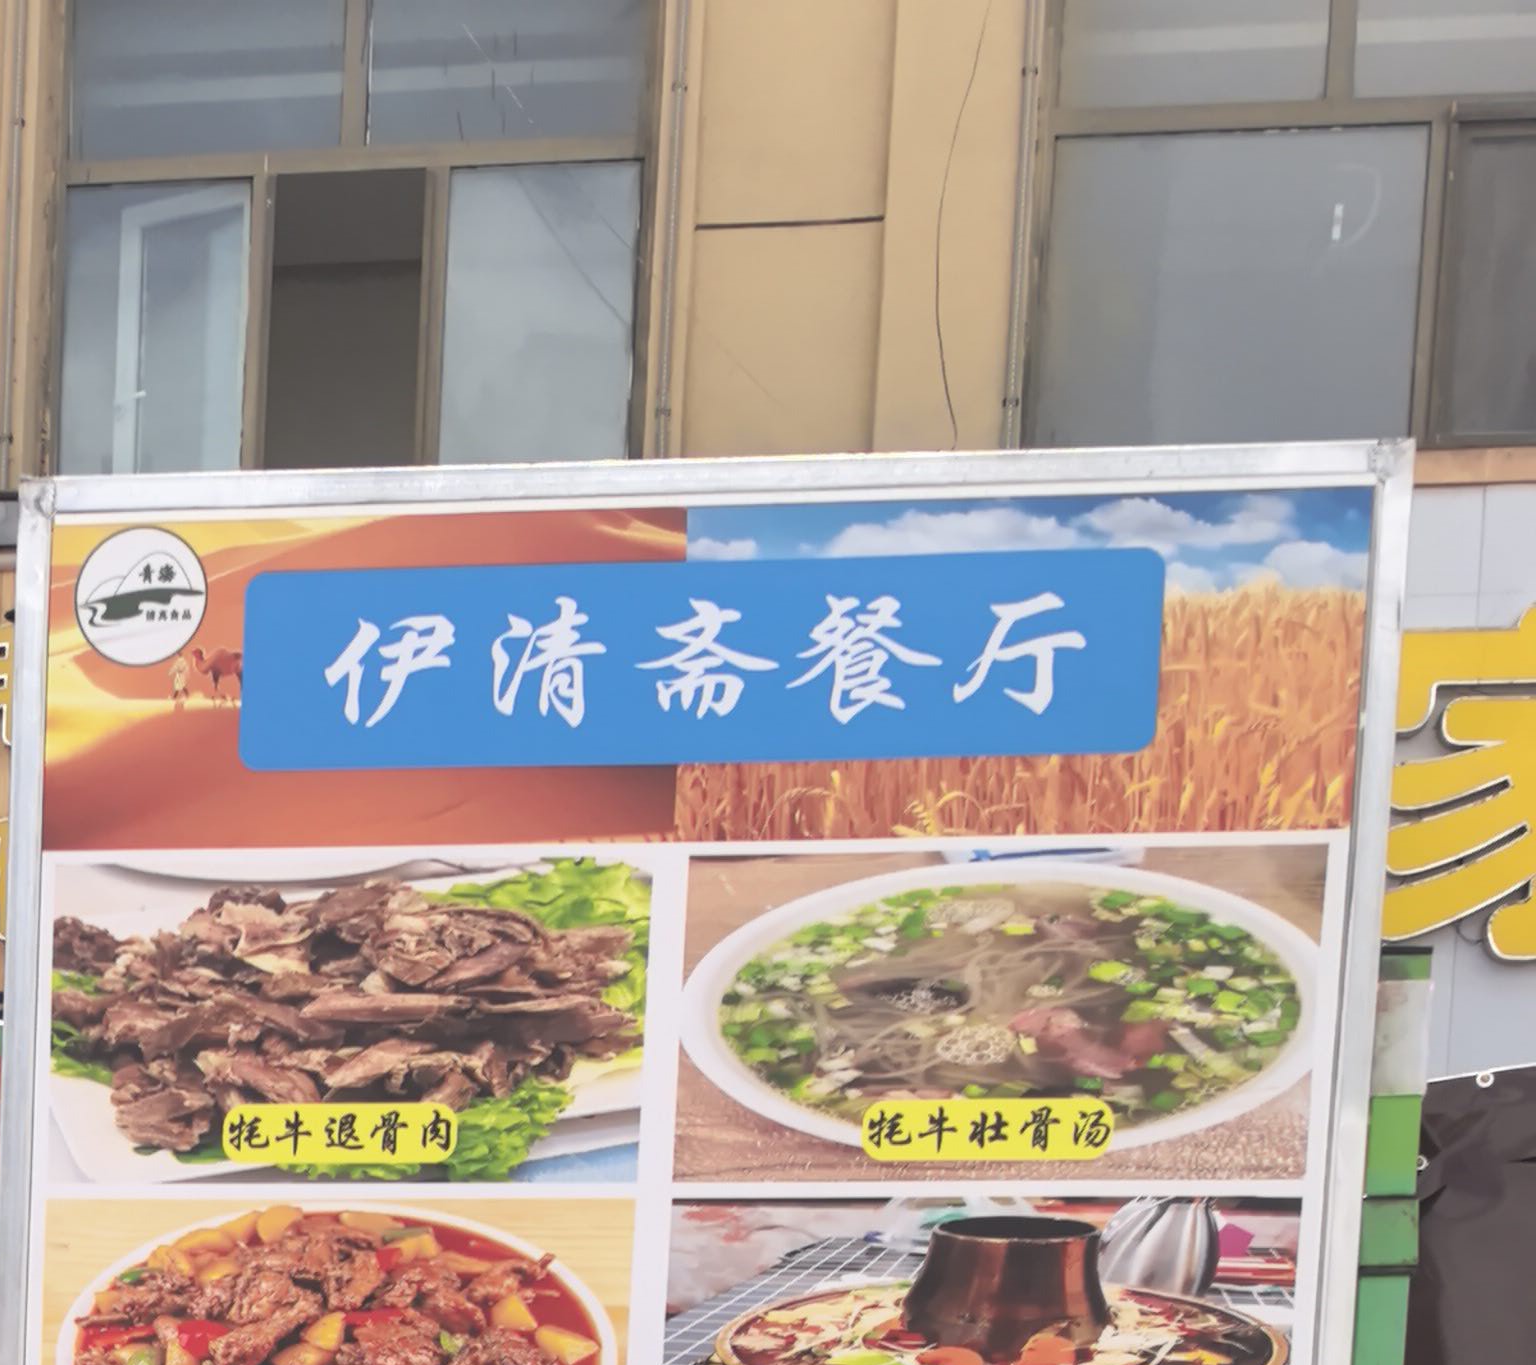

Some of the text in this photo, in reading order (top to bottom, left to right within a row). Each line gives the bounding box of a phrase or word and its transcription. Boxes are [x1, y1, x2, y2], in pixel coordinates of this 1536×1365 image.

[325, 593, 1086, 727] 伊清斋餐厅
[228, 1111, 453, 1160] 牦牛退骨肉
[868, 1107, 1113, 1151] 牦牛壮骨汤
